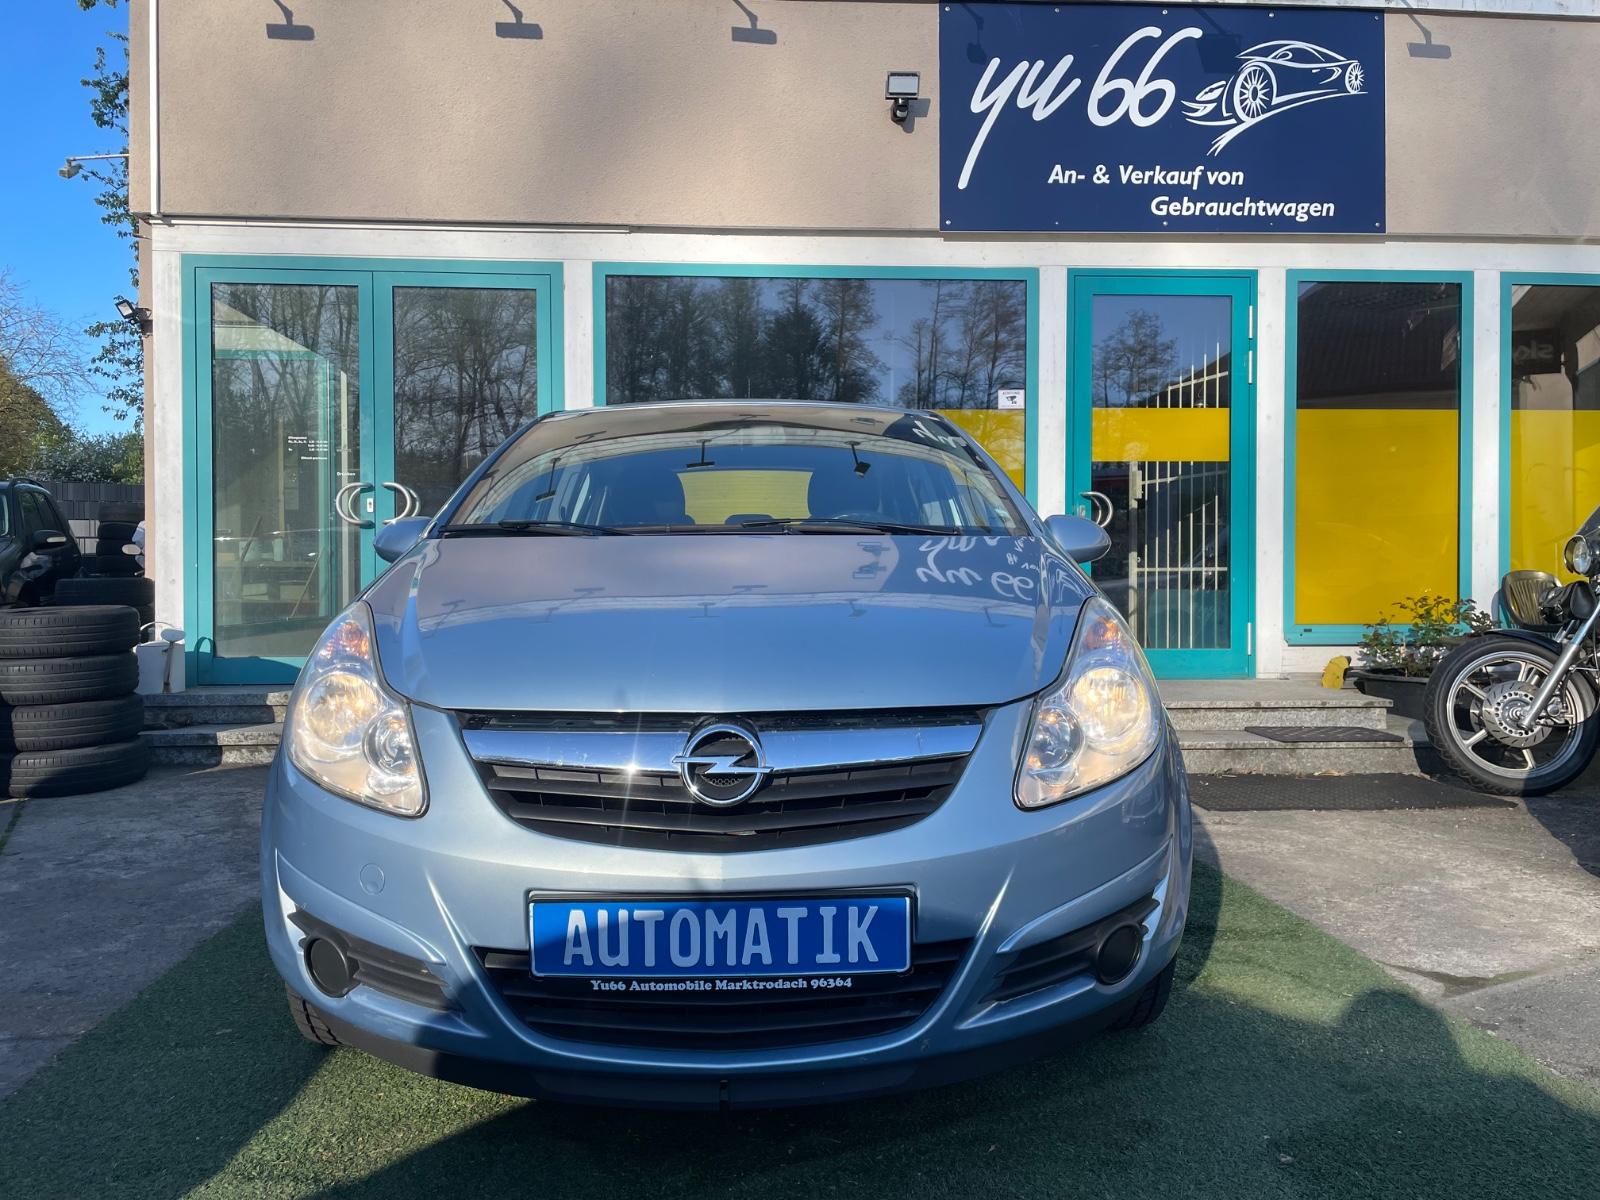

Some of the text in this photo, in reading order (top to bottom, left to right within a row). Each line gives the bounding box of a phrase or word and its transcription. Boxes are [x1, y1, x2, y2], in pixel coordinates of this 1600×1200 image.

[957, 26, 1203, 190] yu 66
[1047, 164, 1244, 191] An- & Verkauf von
[1150, 195, 1336, 222] Gebrauchtwagen
[563, 904, 880, 968] AUTOMATIK
[590, 977, 852, 991] Yu66 Automobile Marktrodach 96364
